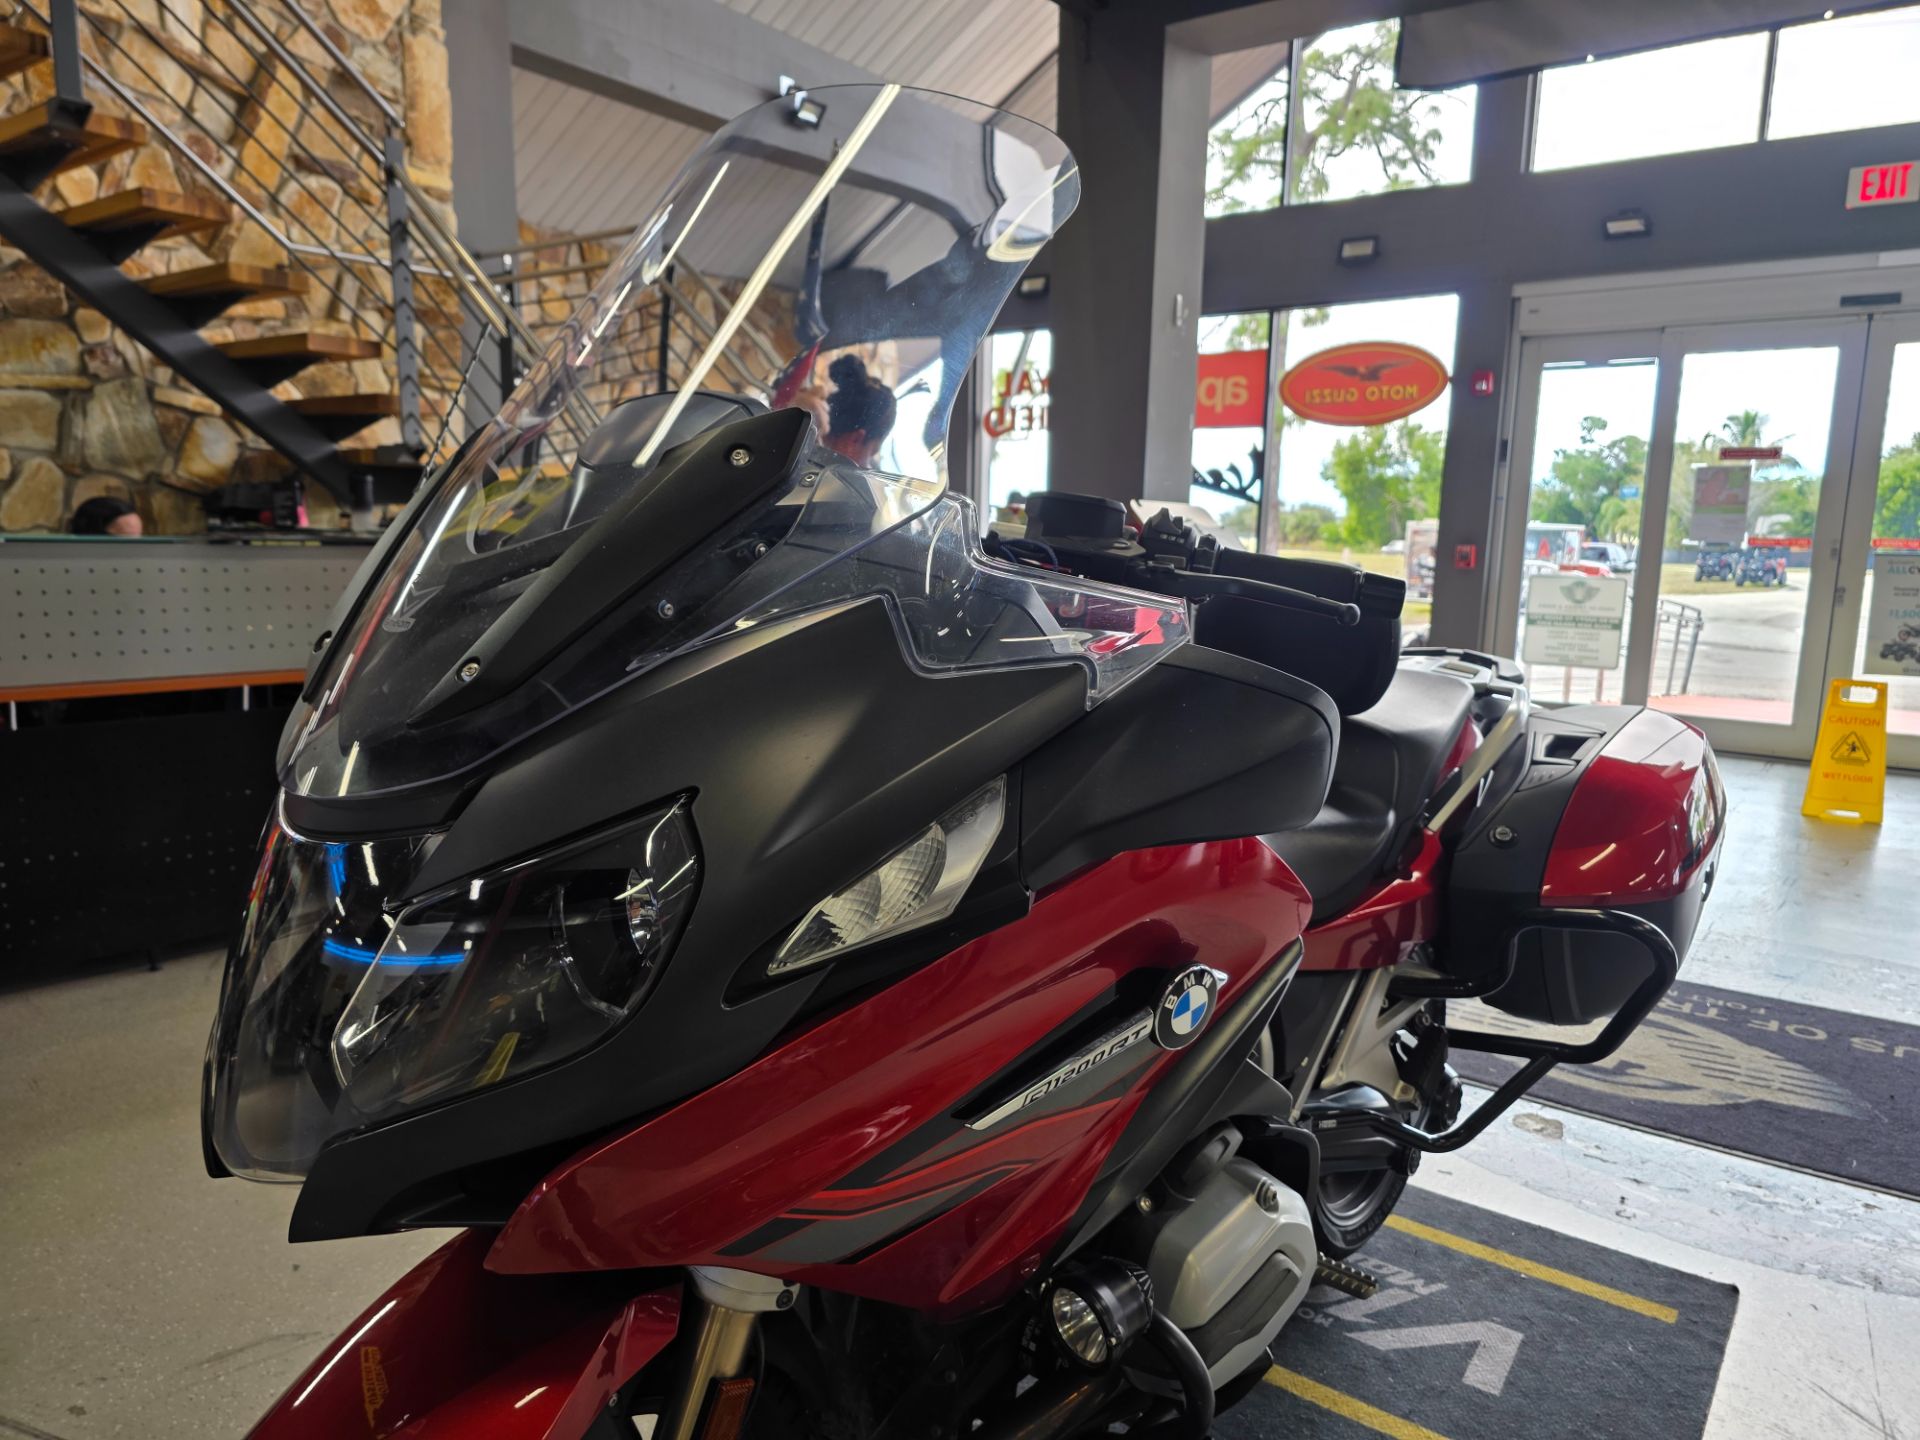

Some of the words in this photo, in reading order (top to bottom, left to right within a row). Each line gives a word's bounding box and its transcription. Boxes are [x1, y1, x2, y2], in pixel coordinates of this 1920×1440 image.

[1860, 163, 1913, 201] EXIT
[1829, 714, 1881, 728] CAUTION
[1823, 771, 1841, 781] WET
[1843, 773, 1874, 784] FLOOR
[1164, 972, 1213, 1010] BMW
[1747, 1018, 1827, 1041] OF
